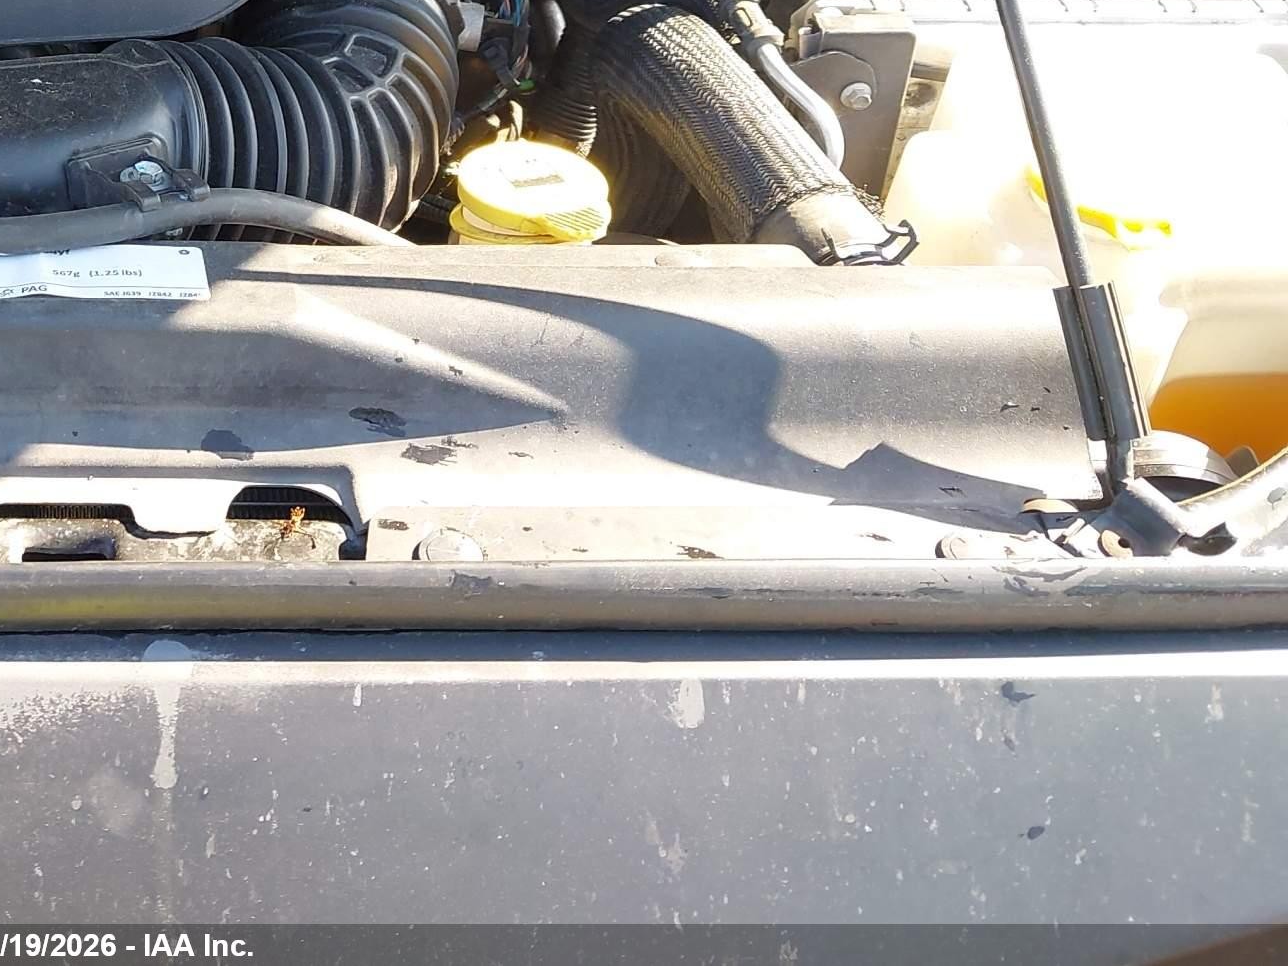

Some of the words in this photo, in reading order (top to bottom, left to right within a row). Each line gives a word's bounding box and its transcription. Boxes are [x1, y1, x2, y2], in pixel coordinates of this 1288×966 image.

[52, 269, 80, 278] 567g
[89, 269, 120, 278] (1.25
[121, 269, 143, 278] lbs)
[21, 284, 48, 293] PAG
